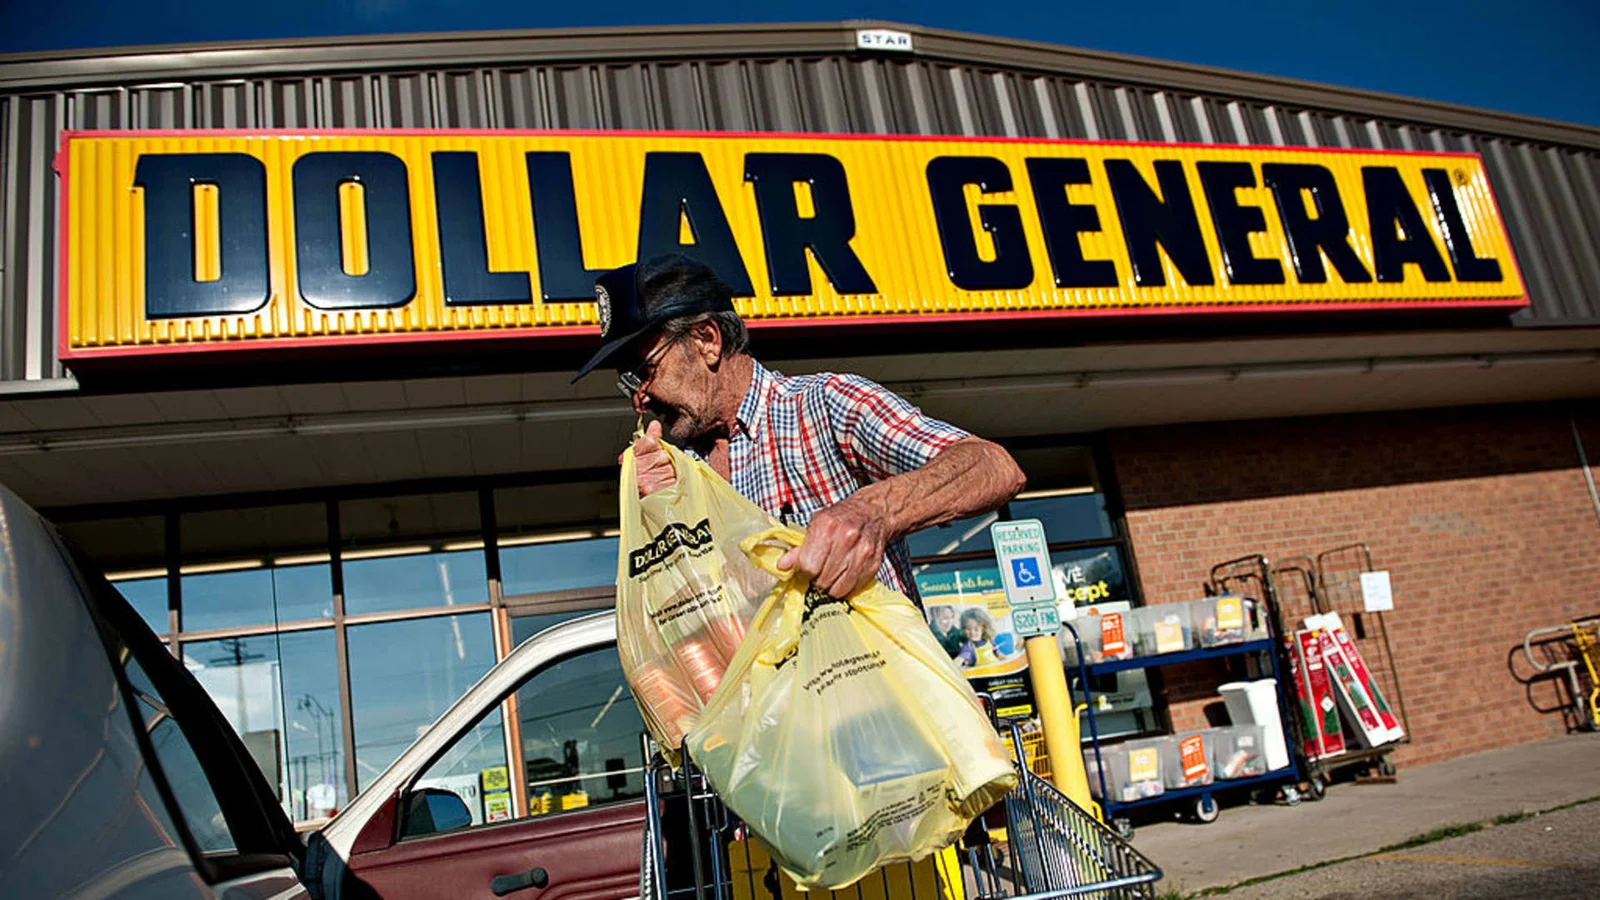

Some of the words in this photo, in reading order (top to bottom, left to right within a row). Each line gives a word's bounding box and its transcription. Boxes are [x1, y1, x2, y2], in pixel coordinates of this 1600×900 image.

[862, 34, 907, 44] STAR
[134, 151, 878, 320] DOLLAR
[926, 156, 1504, 291] GENERAL
[996, 529, 1040, 541] RESERVED
[1002, 542, 1040, 555] PARKING
[921, 581, 952, 592] Success
[952, 577, 976, 590] sarts
[976, 575, 995, 587] here
[1015, 614, 1039, 629] $200
[1040, 611, 1057, 625] FINE
